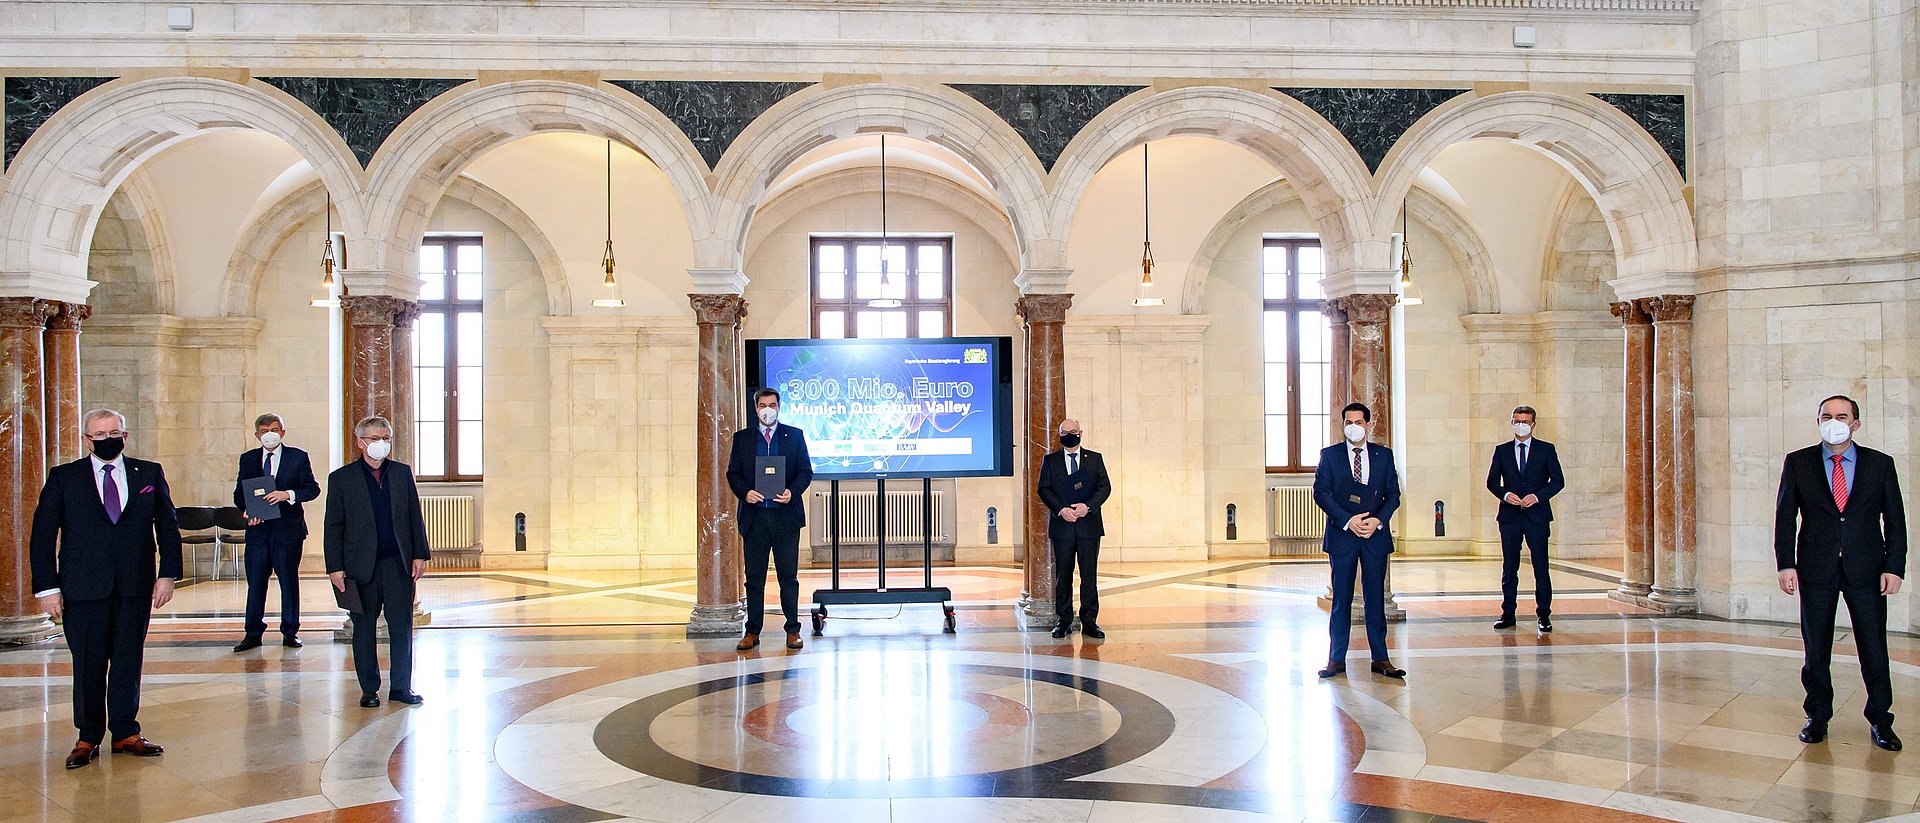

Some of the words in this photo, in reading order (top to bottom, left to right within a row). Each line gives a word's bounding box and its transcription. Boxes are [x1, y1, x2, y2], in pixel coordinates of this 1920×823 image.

[788, 378, 840, 401] 300
[848, 377, 904, 400] Mio.
[912, 376, 974, 399] Euro
[789, 401, 847, 416] Munich
[850, 401, 922, 415] Quantum
[925, 400, 972, 416] Valley
